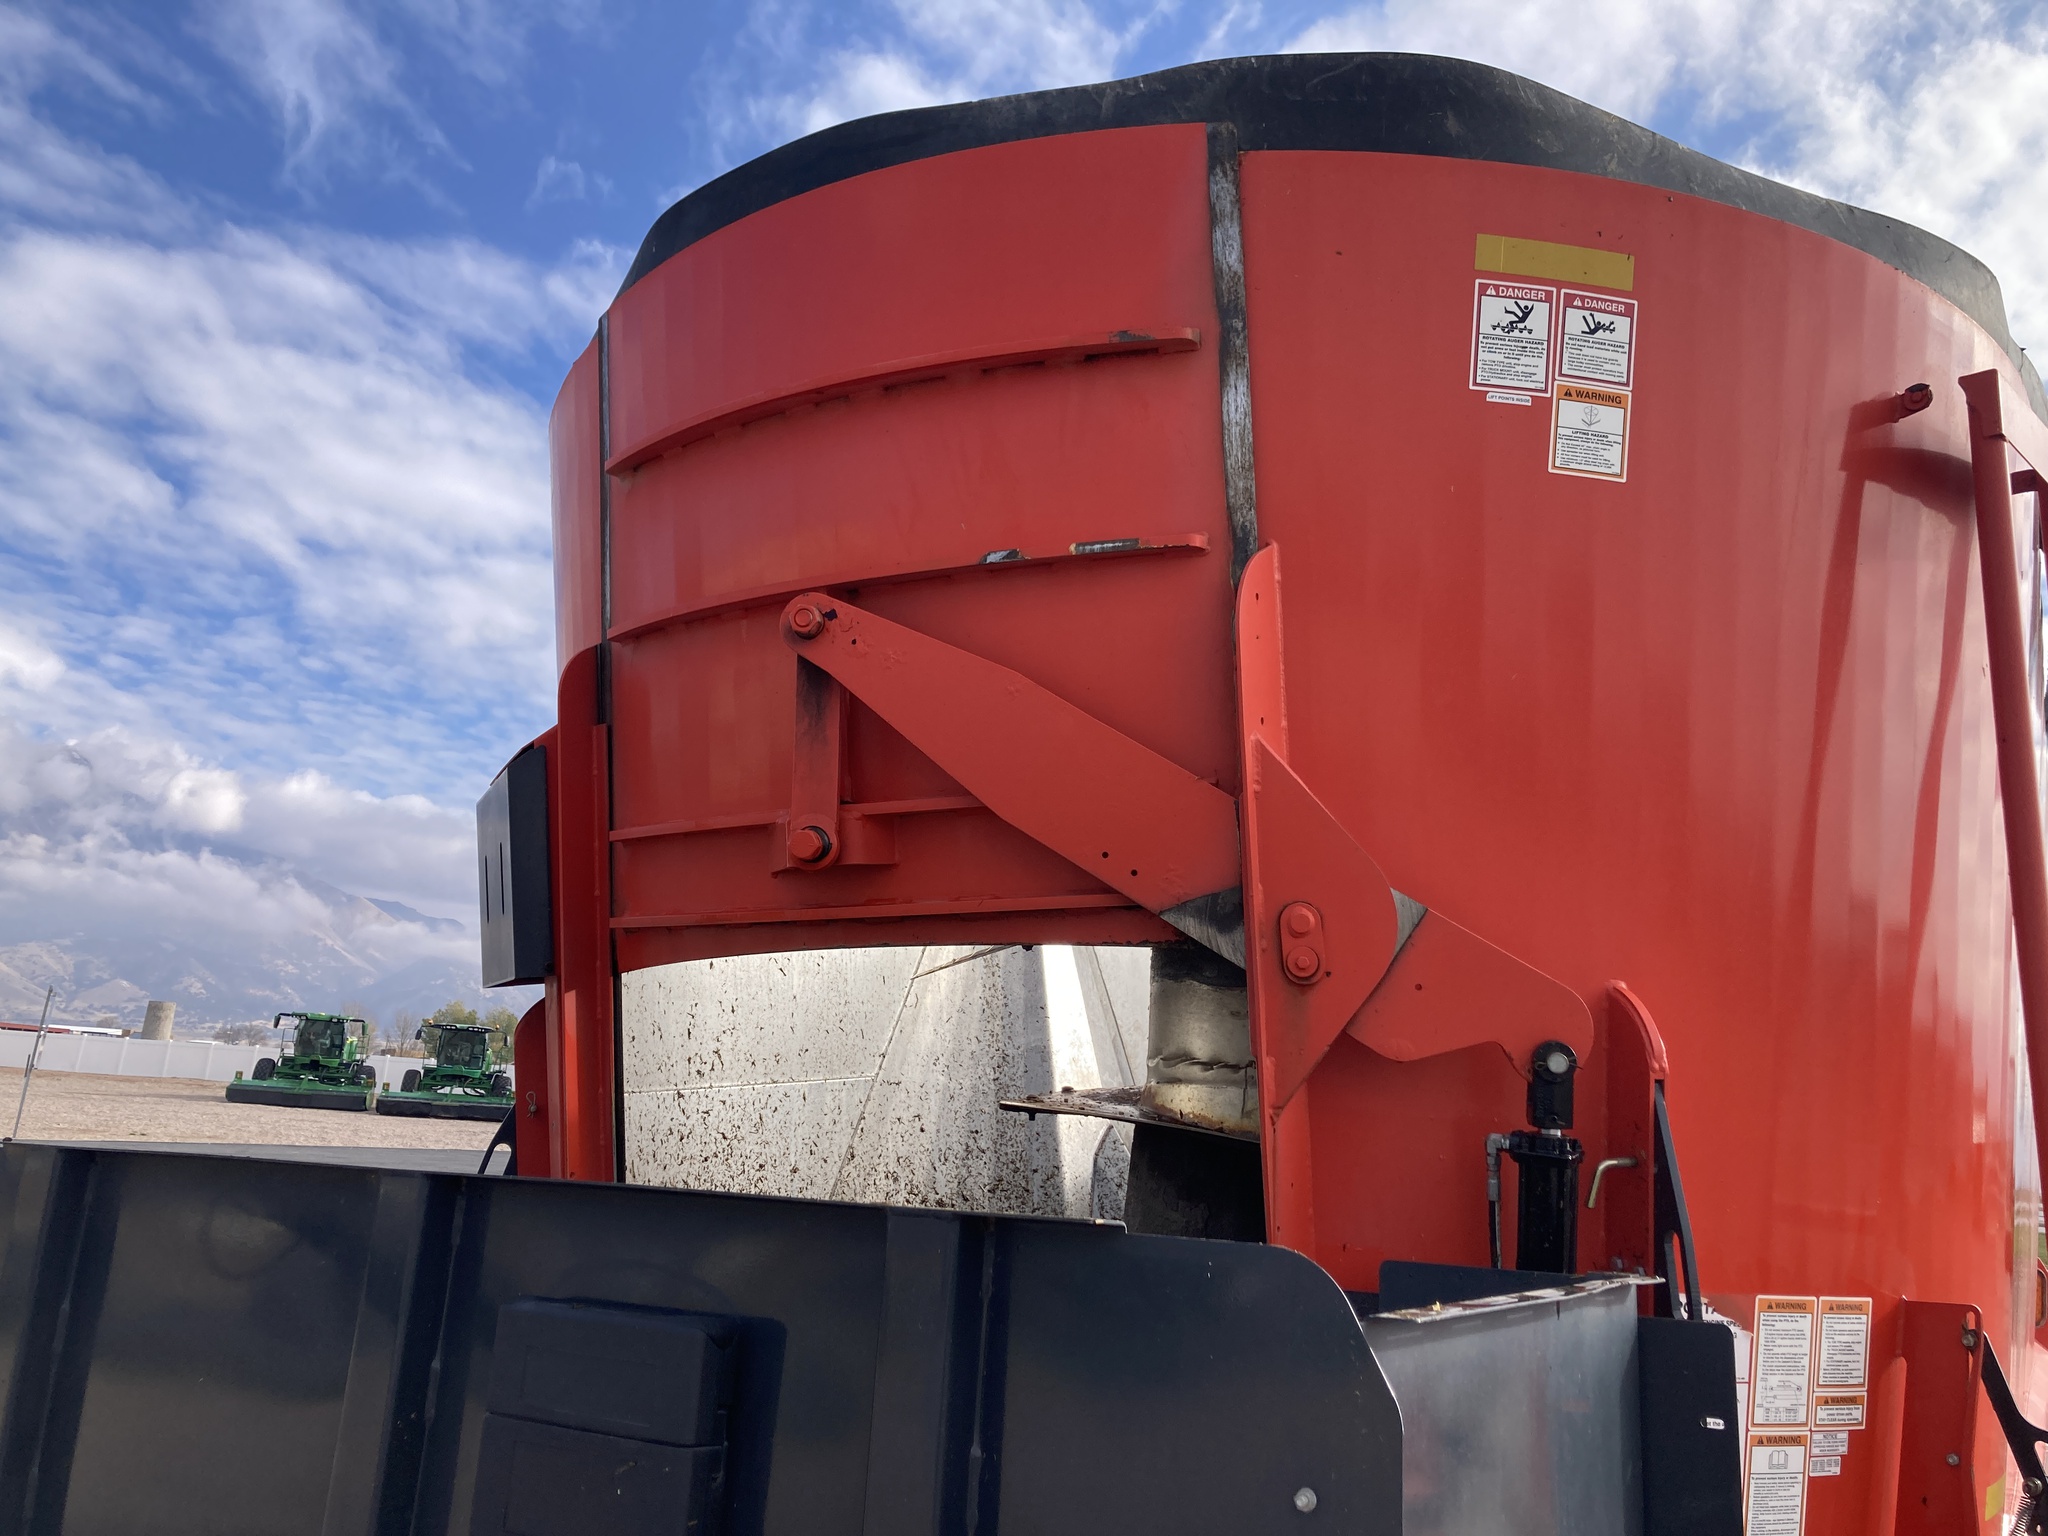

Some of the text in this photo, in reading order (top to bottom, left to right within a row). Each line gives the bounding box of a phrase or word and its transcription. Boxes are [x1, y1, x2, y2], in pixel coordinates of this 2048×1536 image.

[1499, 286, 1545, 300] DANGER
[1584, 299, 1625, 313] DANGER
[1576, 390, 1622, 404] WARNING
[1766, 1436, 1801, 1444] WARNING
